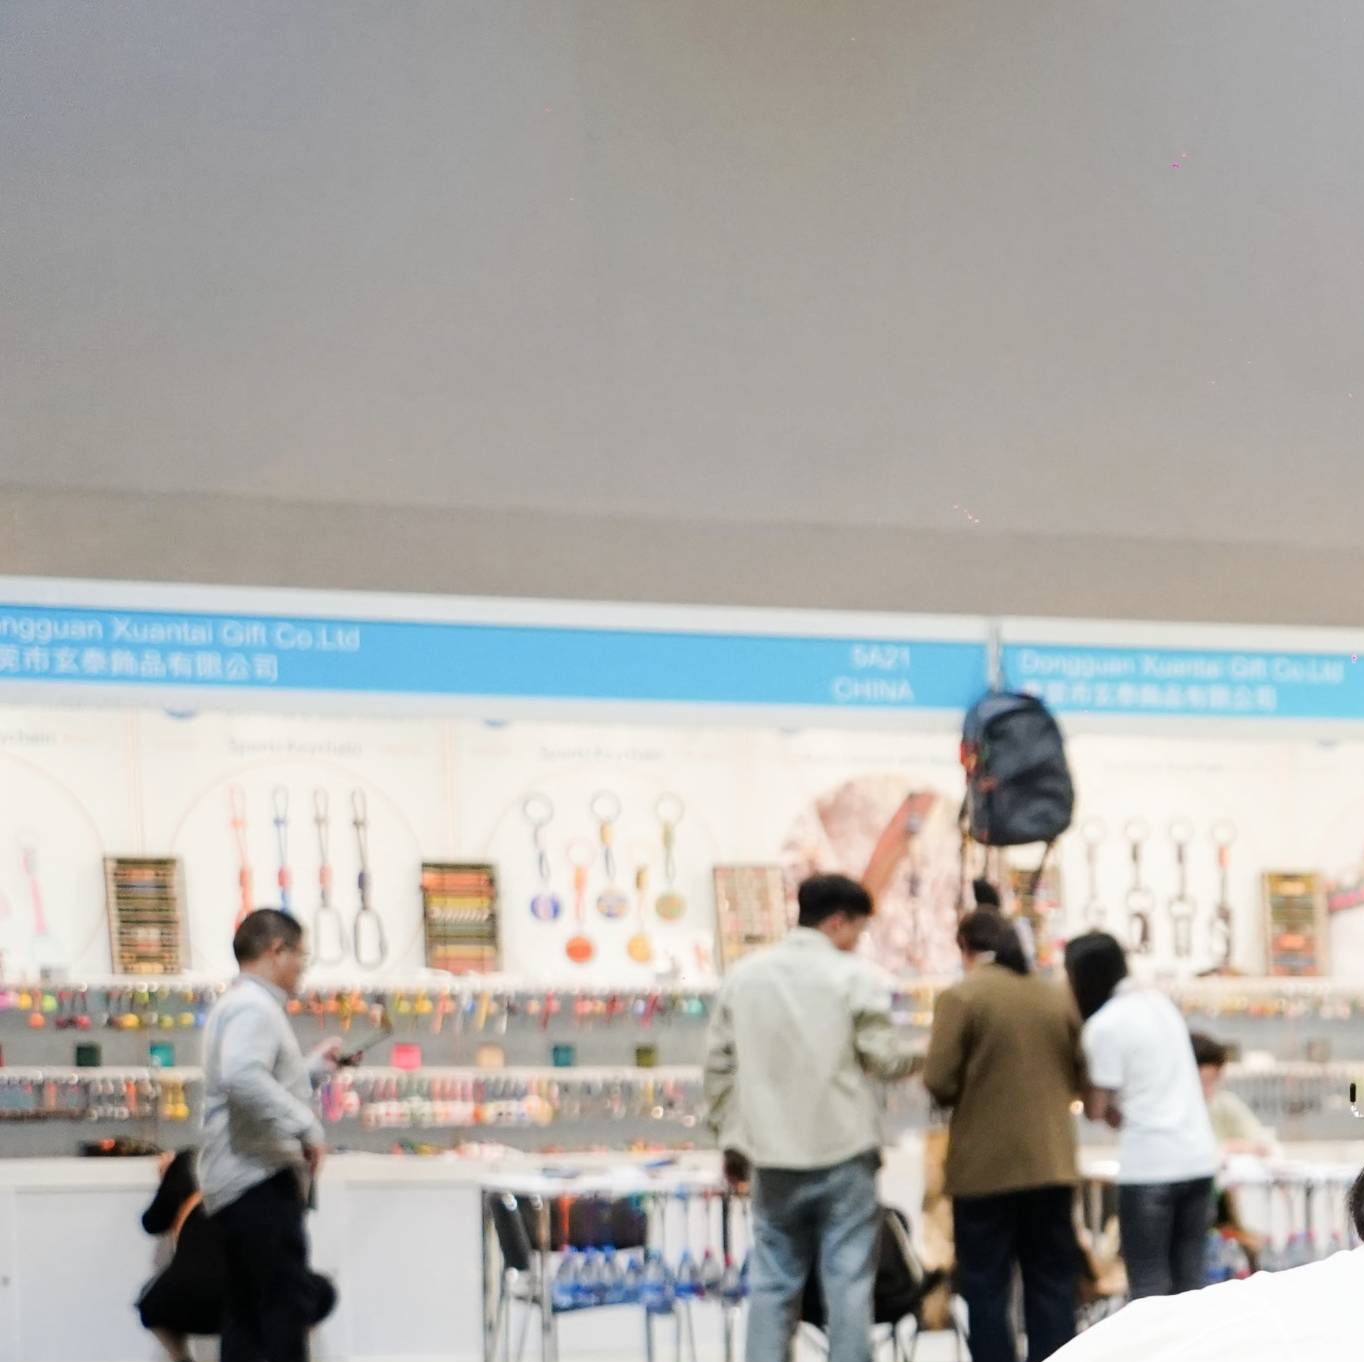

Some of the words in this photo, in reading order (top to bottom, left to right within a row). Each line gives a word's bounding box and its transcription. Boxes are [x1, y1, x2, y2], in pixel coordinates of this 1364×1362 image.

[111, 617, 213, 645] Xuantai
[222, 622, 268, 648] Gift
[831, 677, 914, 702] CHINA
